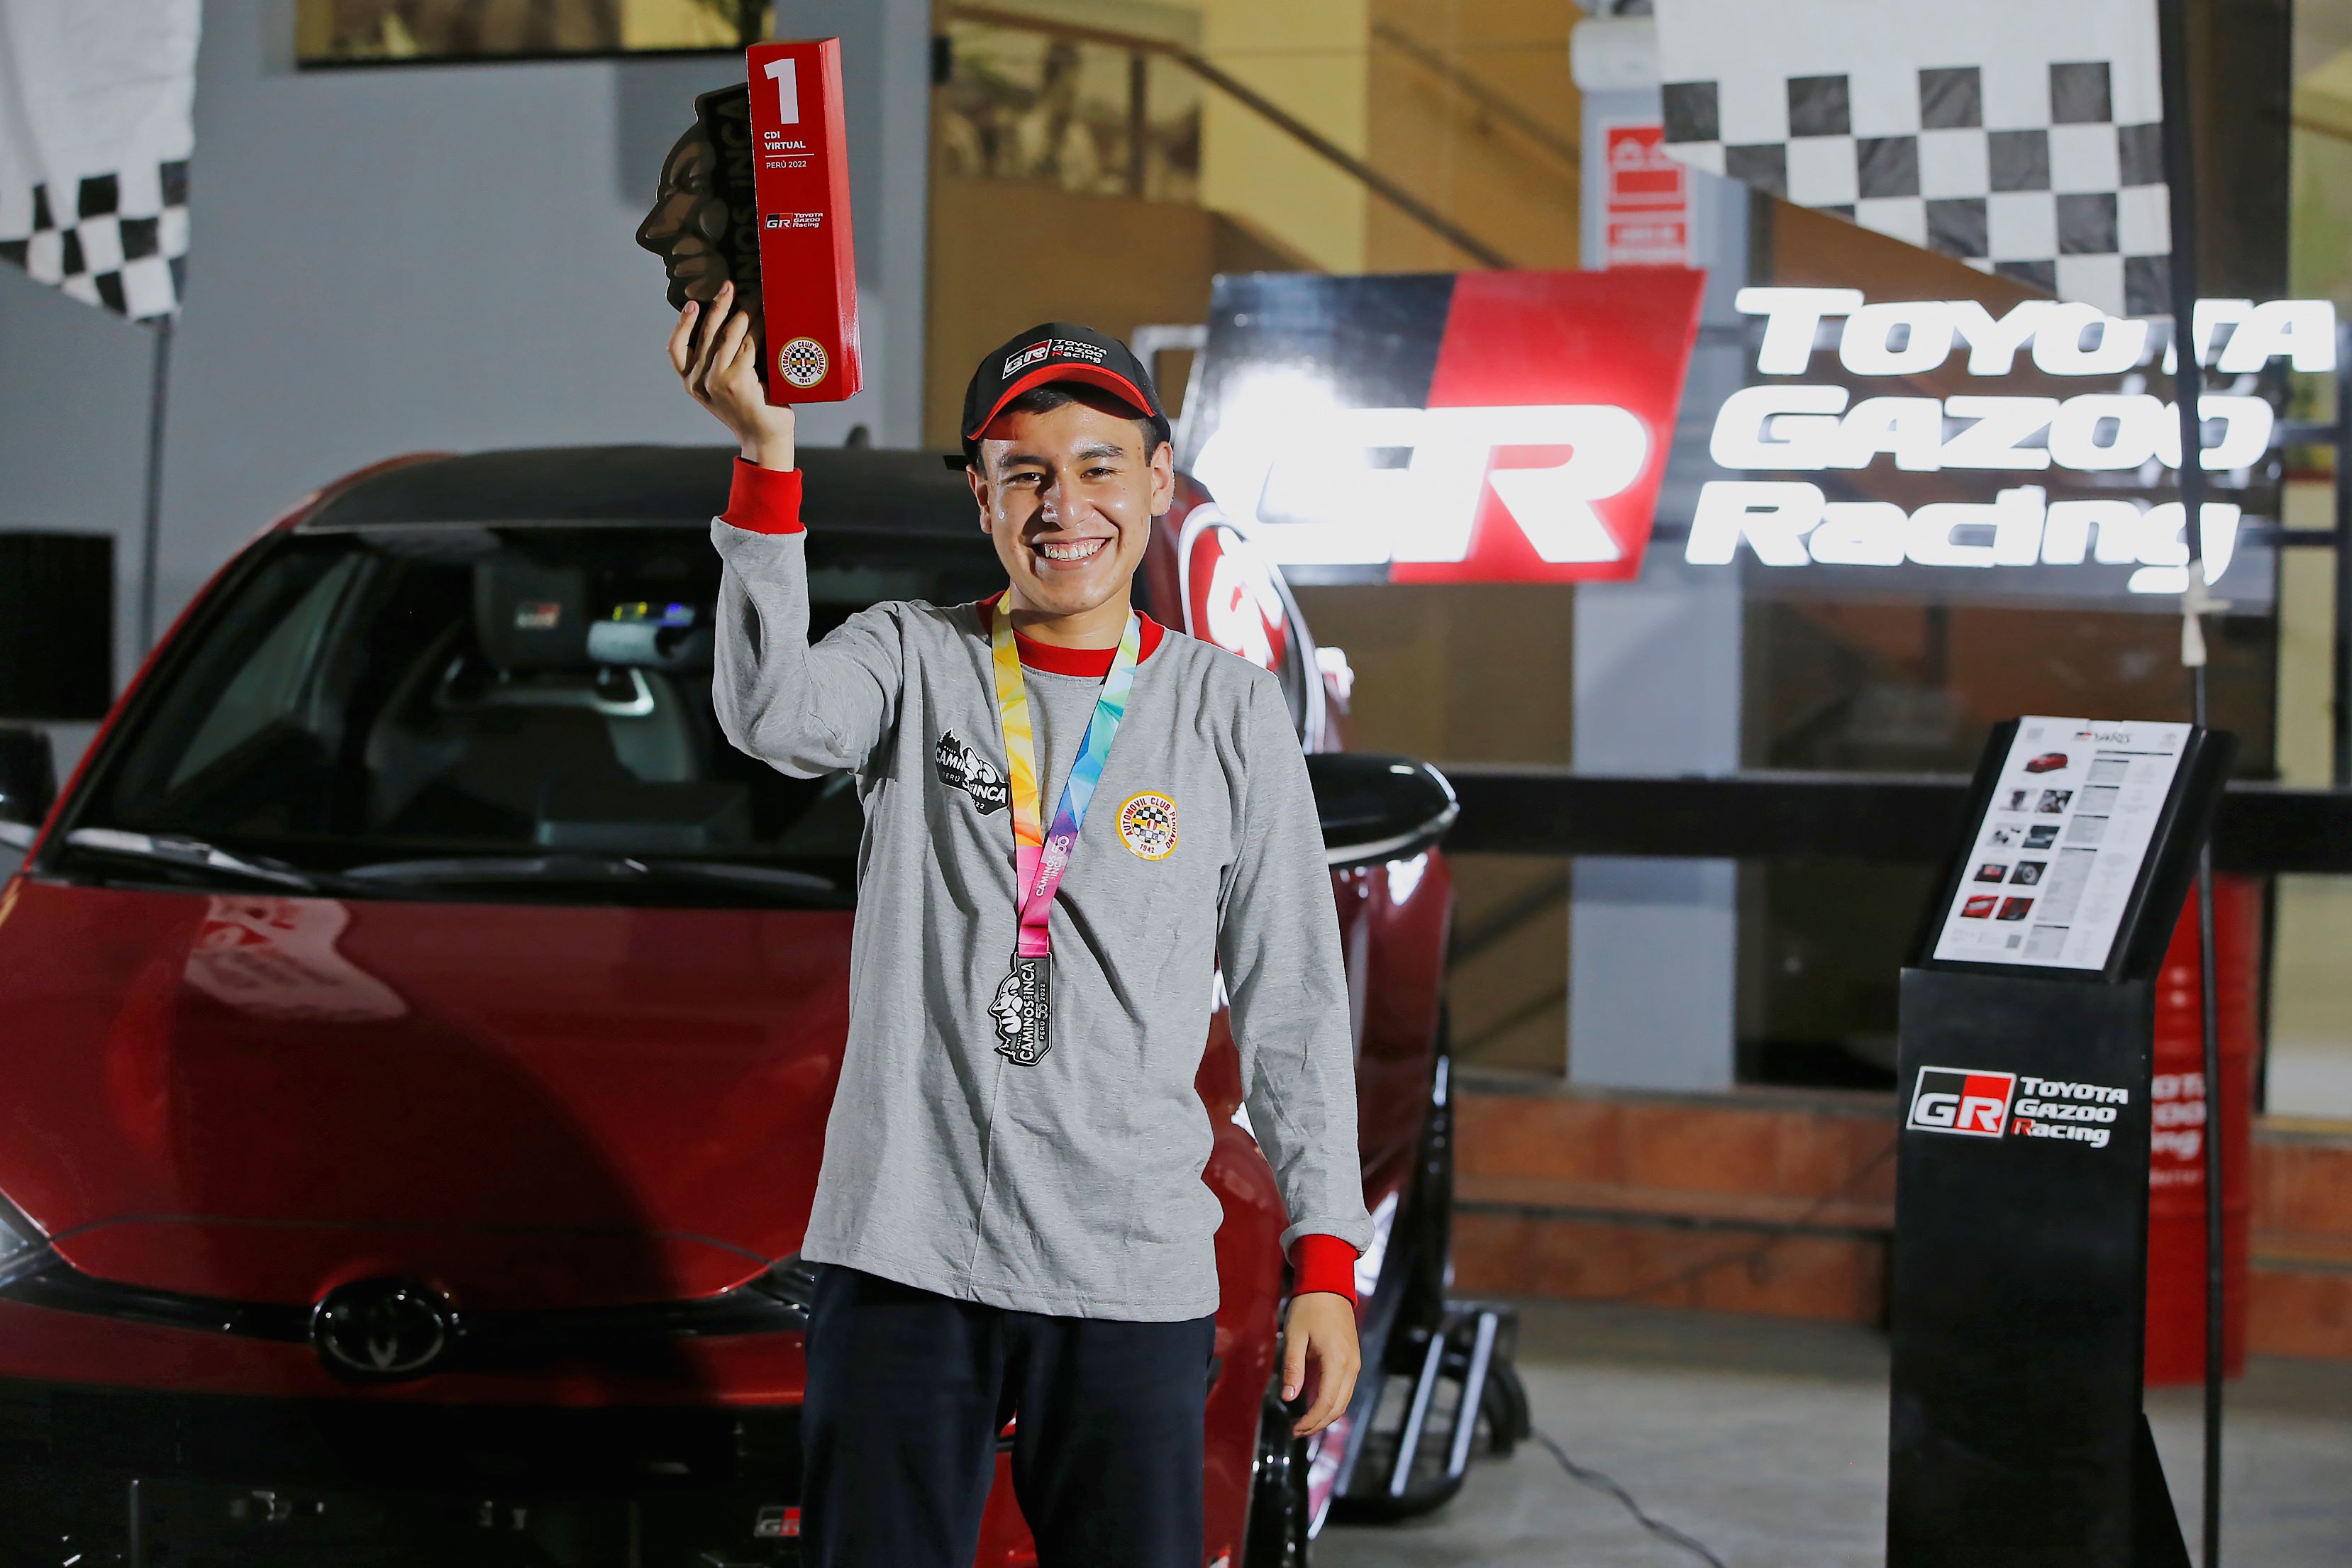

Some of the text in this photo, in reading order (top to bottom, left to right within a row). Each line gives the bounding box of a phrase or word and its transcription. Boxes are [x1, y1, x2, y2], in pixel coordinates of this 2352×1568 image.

[763, 58, 799, 125] 1
[764, 130, 780, 140] CDI
[764, 140, 806, 150] VIRTUAL
[766, 160, 806, 169] PERÚ 2022
[766, 219, 791, 228] GR
[1005, 347, 1046, 373] GR
[1052, 352, 1101, 364] Racing
[1053, 345, 1103, 358] GAZOO
[1055, 340, 1106, 355] TOYOTA
[1710, 384, 2273, 472] GAZOO
[1685, 481, 2241, 594] Racing
[972, 784, 1007, 804] INCA
[1124, 798, 1147, 835] AUTOMOVIL
[1151, 797, 1170, 811] CLUB
[1140, 844, 1155, 853] 1942
[1036, 855, 1057, 897] CAMINOS
[1050, 855, 1065, 878] INCA
[1021, 962, 1035, 995] INCA
[1019, 1000, 1035, 1061] CAMINOS
[2019, 1076, 2129, 1105] TOYOTA
[1914, 1092, 2004, 1133] GR
[2014, 1098, 2117, 1123] GAZOO
[2011, 1117, 2111, 1148] Racing
